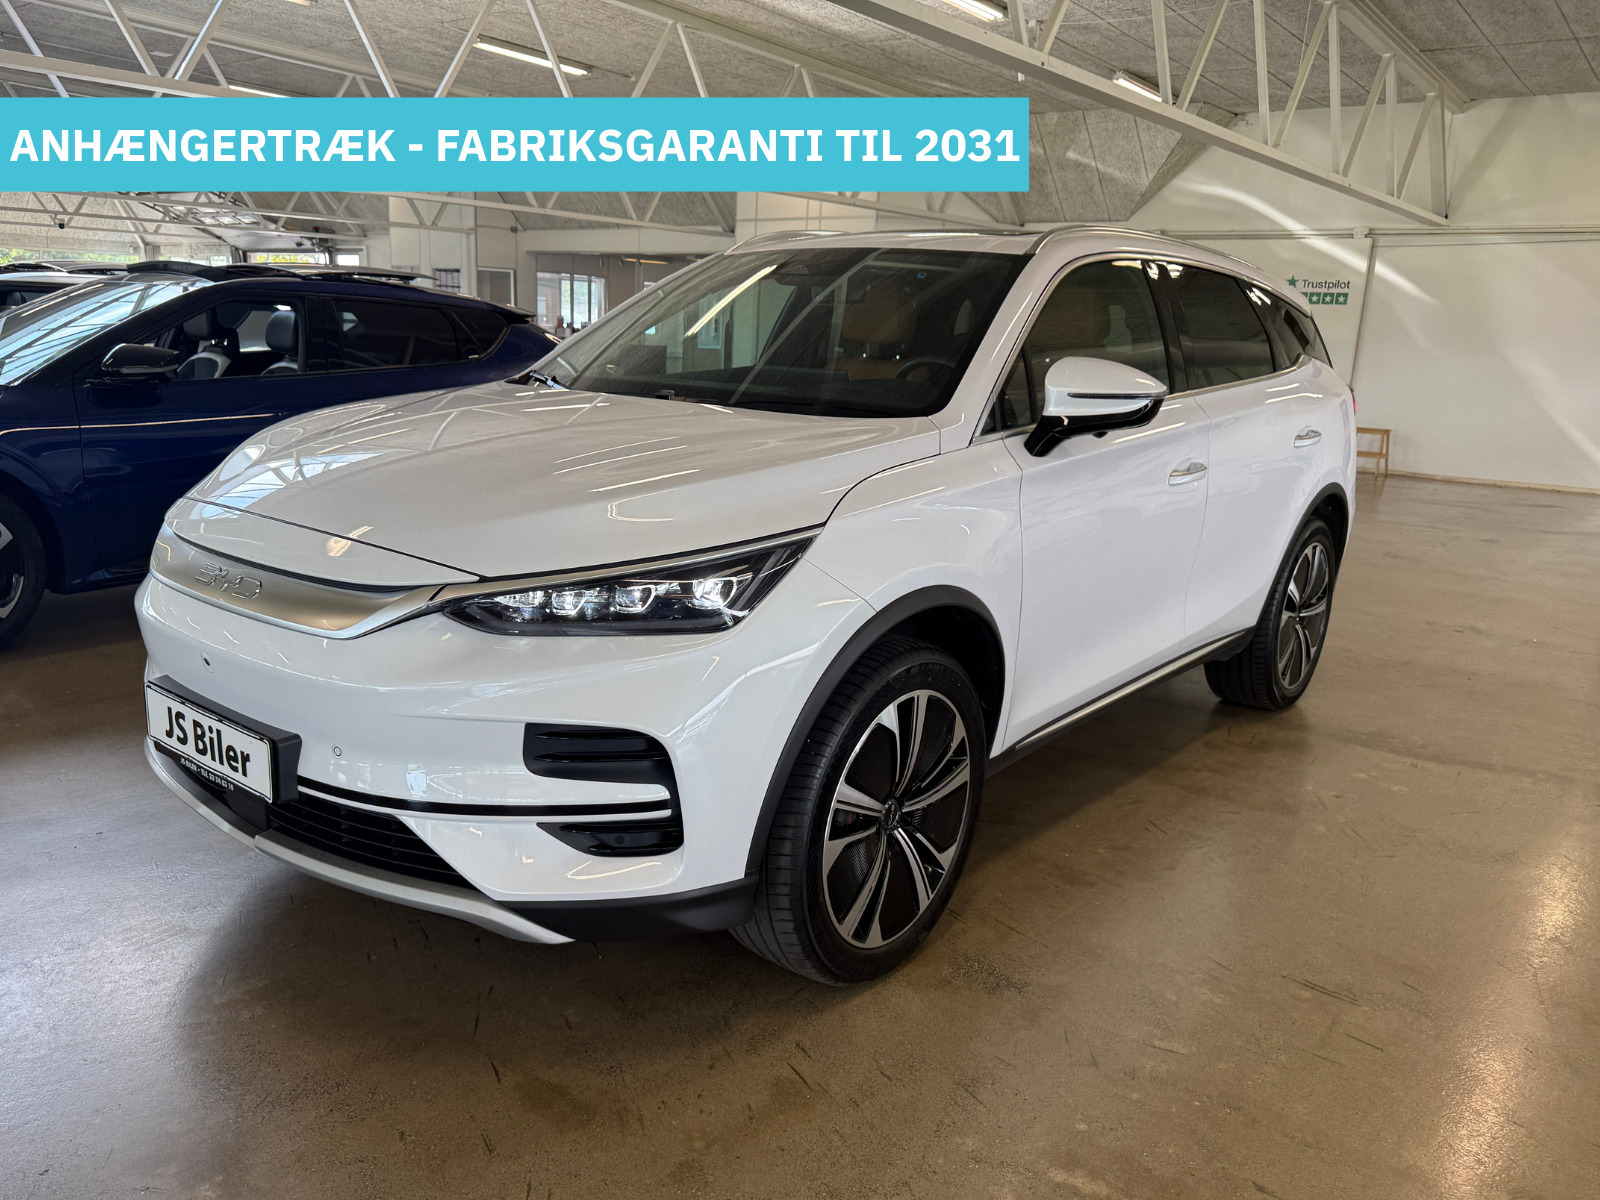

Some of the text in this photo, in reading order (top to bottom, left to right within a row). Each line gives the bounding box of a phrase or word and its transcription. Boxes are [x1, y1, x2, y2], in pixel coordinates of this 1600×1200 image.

[1302, 279, 1351, 291] Trustpilot
[165, 706, 251, 778] JS Biler
